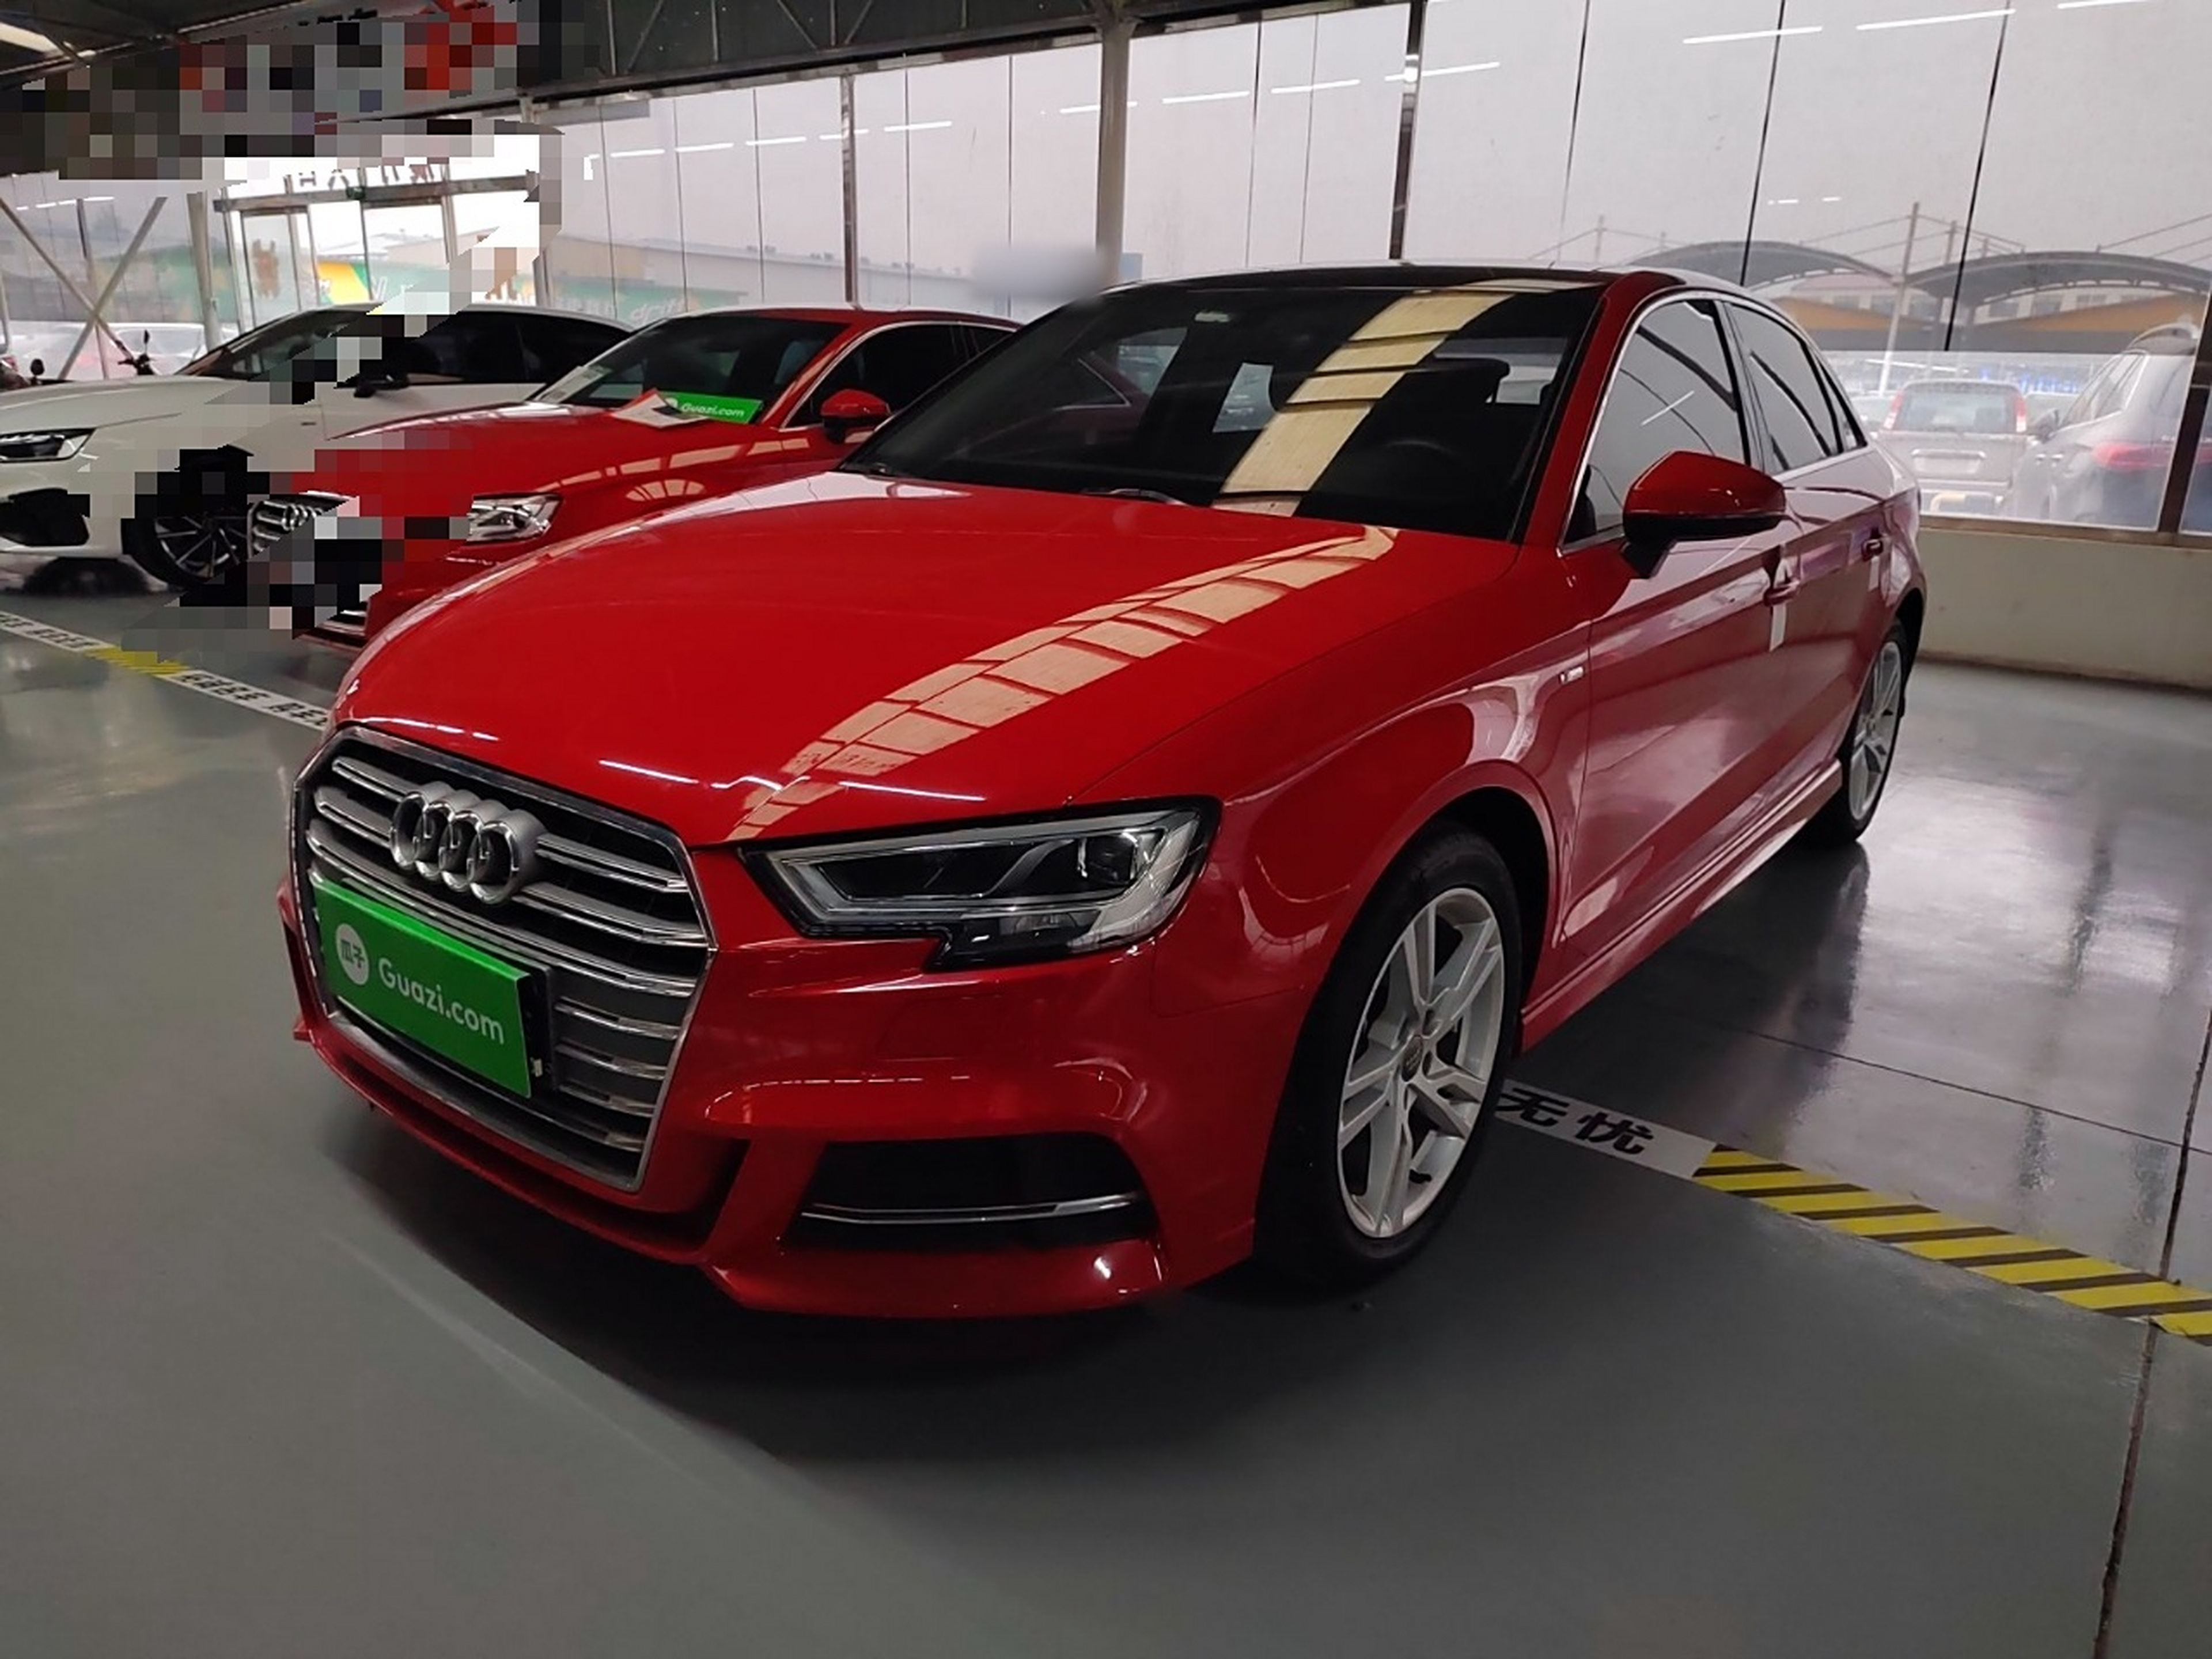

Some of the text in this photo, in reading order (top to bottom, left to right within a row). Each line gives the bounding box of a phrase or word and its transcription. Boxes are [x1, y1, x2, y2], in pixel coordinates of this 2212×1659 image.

[681, 403, 745, 418] Guazi.com
[340, 939, 366, 968] 瓜子
[378, 957, 505, 1045] Guazi.com
[1498, 1087, 1654, 1154] 无忧
